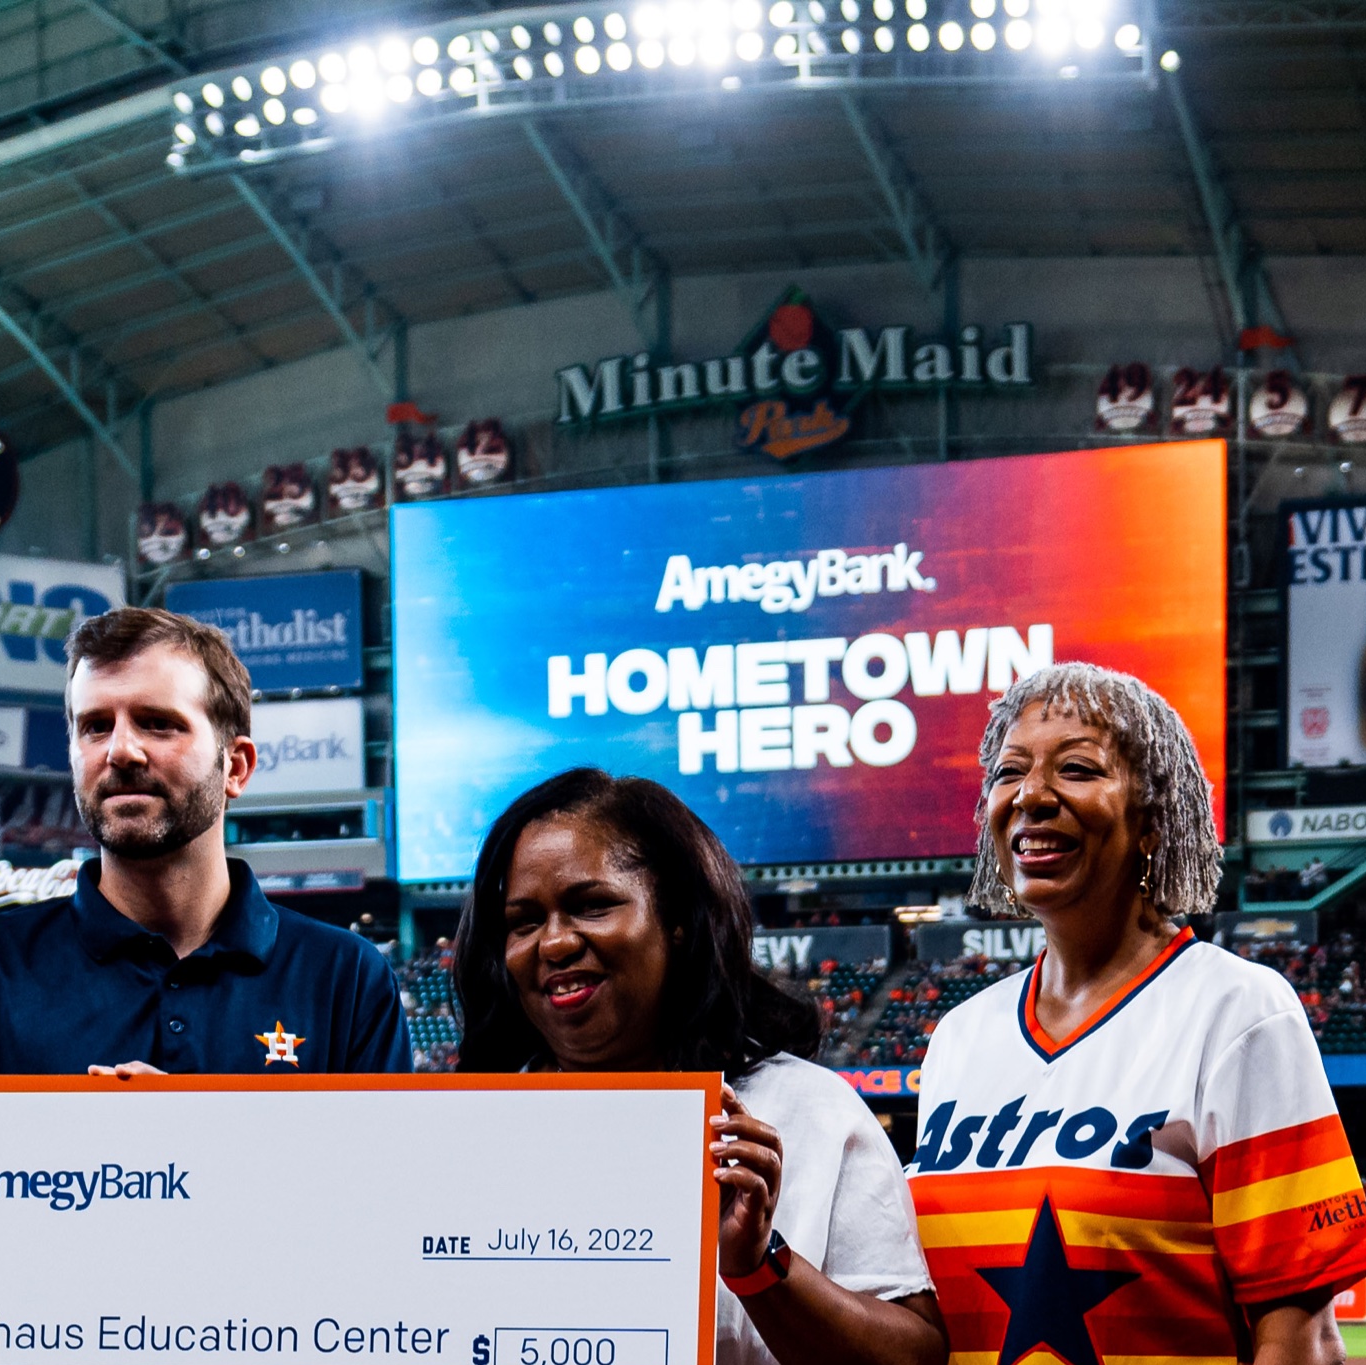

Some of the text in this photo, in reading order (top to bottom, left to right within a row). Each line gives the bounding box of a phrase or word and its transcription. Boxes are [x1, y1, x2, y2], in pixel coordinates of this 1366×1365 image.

[556, 322, 1032, 422] Minute Maid
[739, 400, 850, 458] Park
[225, 608, 348, 649] thodist
[547, 623, 1053, 719] HOMETOWN
[256, 731, 348, 772] gyBank
[678, 698, 918, 775] HERO
[752, 934, 813, 970] EVY
[263, 1032, 299, 1062] H
[904, 1094, 1171, 1173] Astros
[423, 1228, 654, 1255] DATE July 16, 2022
[99, 1316, 298, 1354] Education
[313, 1318, 450, 1355] Center
